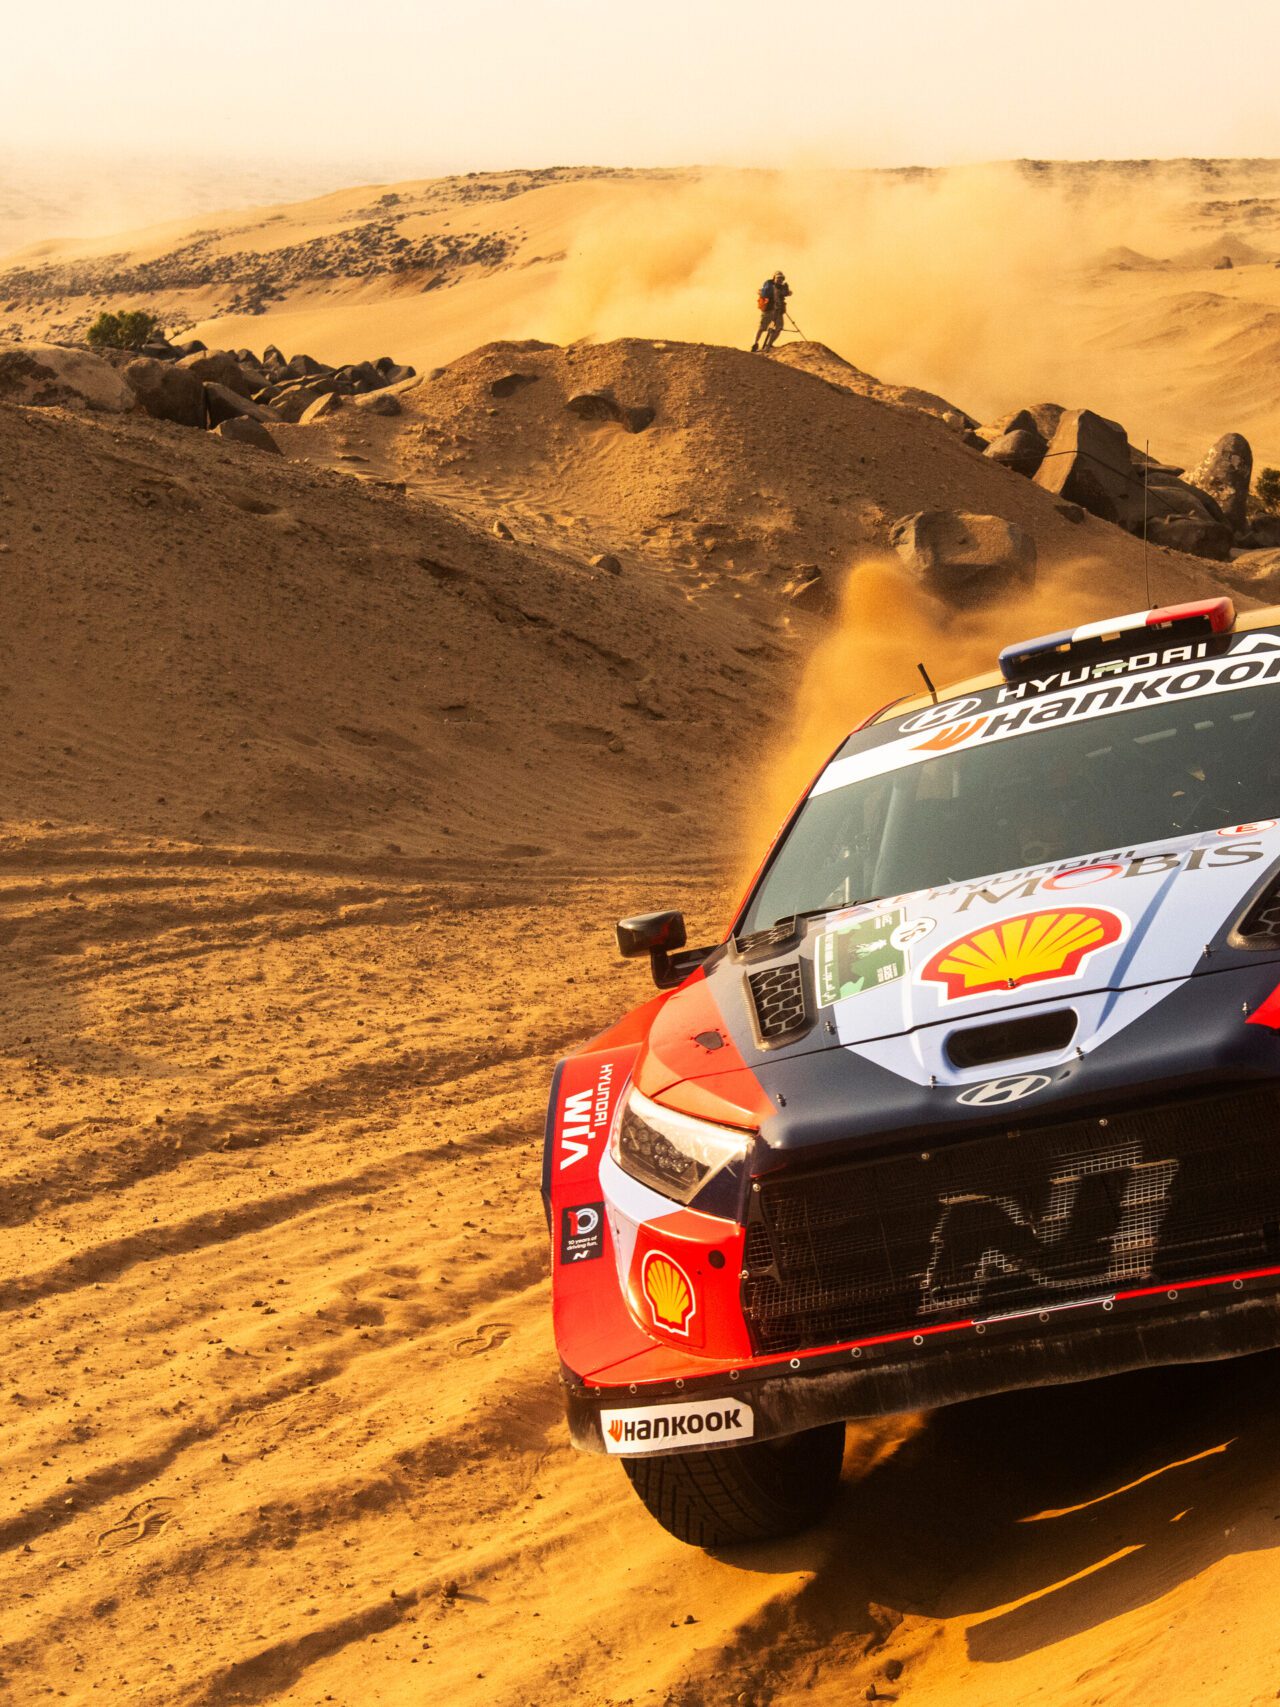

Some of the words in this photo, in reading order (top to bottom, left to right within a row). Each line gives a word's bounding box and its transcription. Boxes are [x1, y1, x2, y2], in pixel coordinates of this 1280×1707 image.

[996, 643, 1206, 703] HYUNDAI
[928, 850, 1136, 900] HYUNDAI
[954, 841, 1264, 914] MOBIS
[594, 1063, 614, 1127] HYUNDAI
